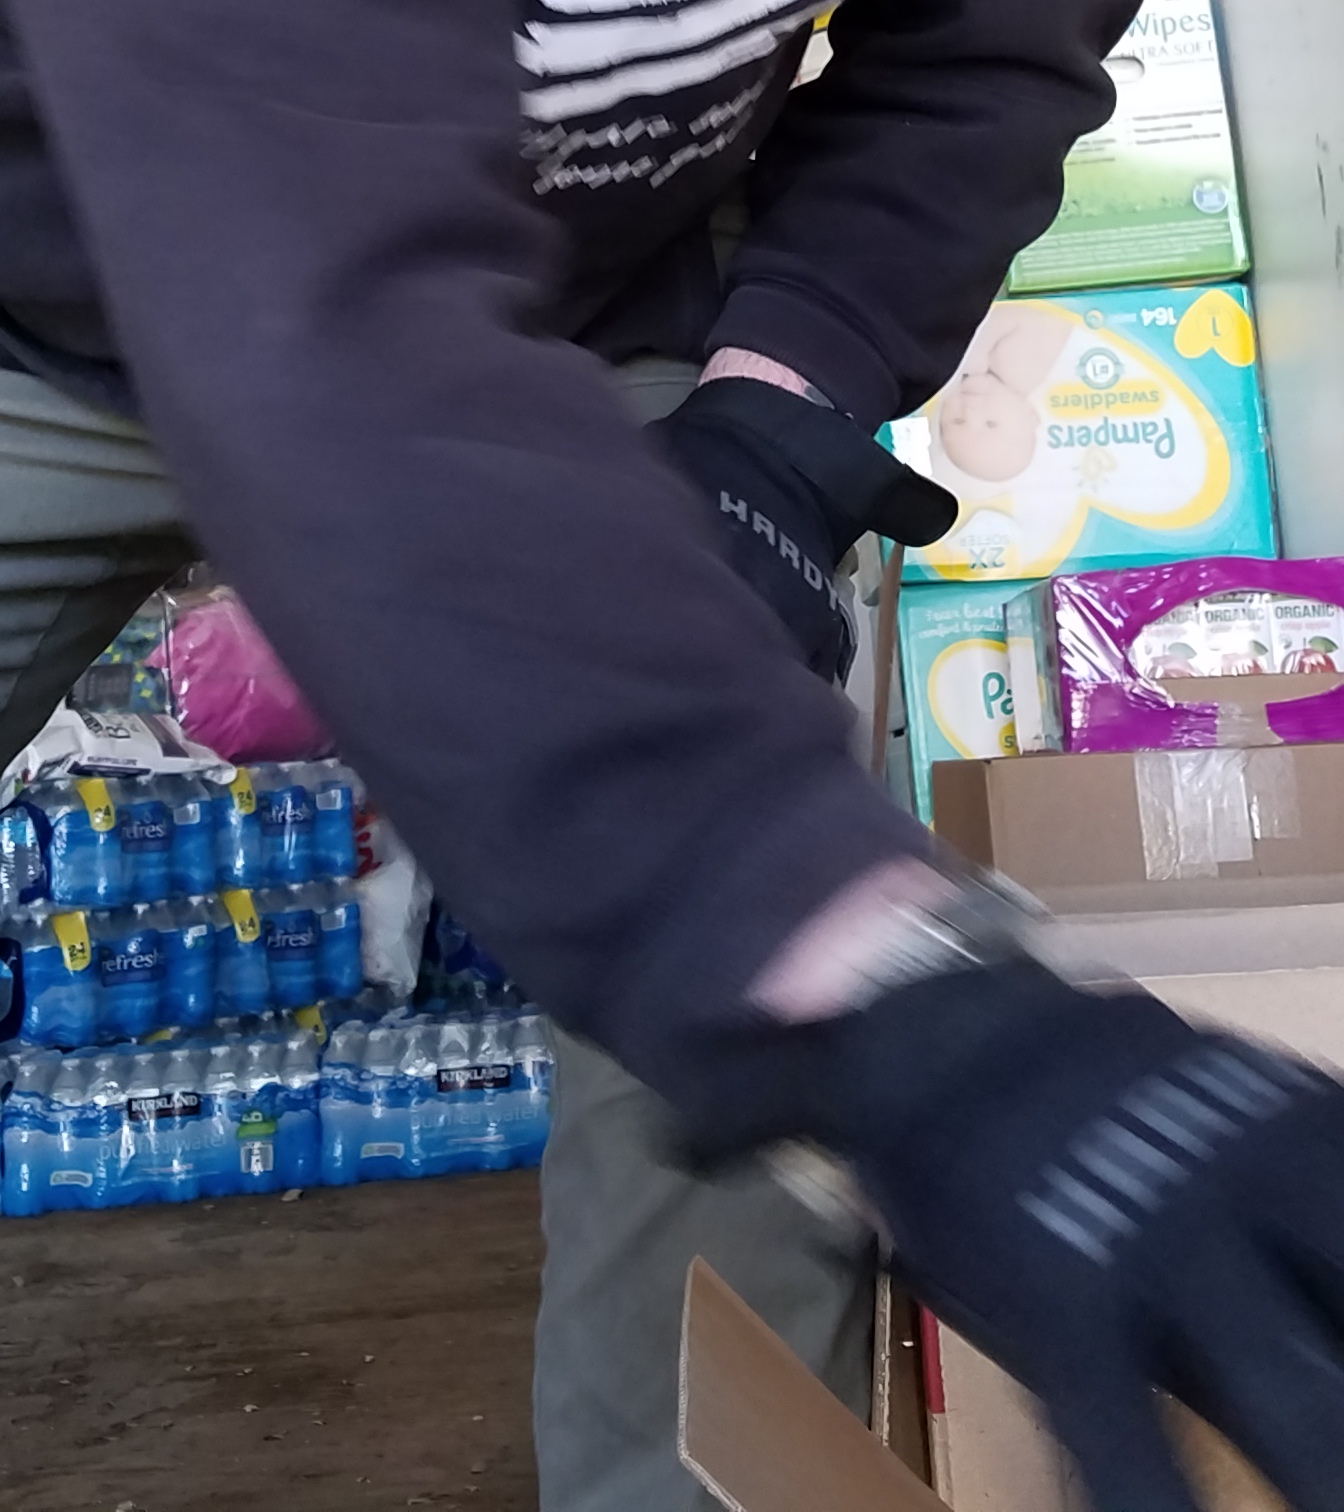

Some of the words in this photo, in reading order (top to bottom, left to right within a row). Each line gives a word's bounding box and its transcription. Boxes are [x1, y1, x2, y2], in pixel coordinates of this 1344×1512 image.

[1127, 12, 1212, 43] Wipes
[1141, 307, 1177, 326] 164
[1050, 390, 1160, 408] swaddlers
[1047, 417, 1176, 459] Pampers
[720, 490, 838, 611] HARDY
[970, 547, 1005, 569] 2X
[1206, 607, 1265, 622] ORGANIC
[1275, 604, 1334, 620] ORGANIC
[68, 942, 86, 959] 24
[440, 1066, 508, 1083] KIRKLAND
[131, 1094, 198, 1111] KIRKLAND
